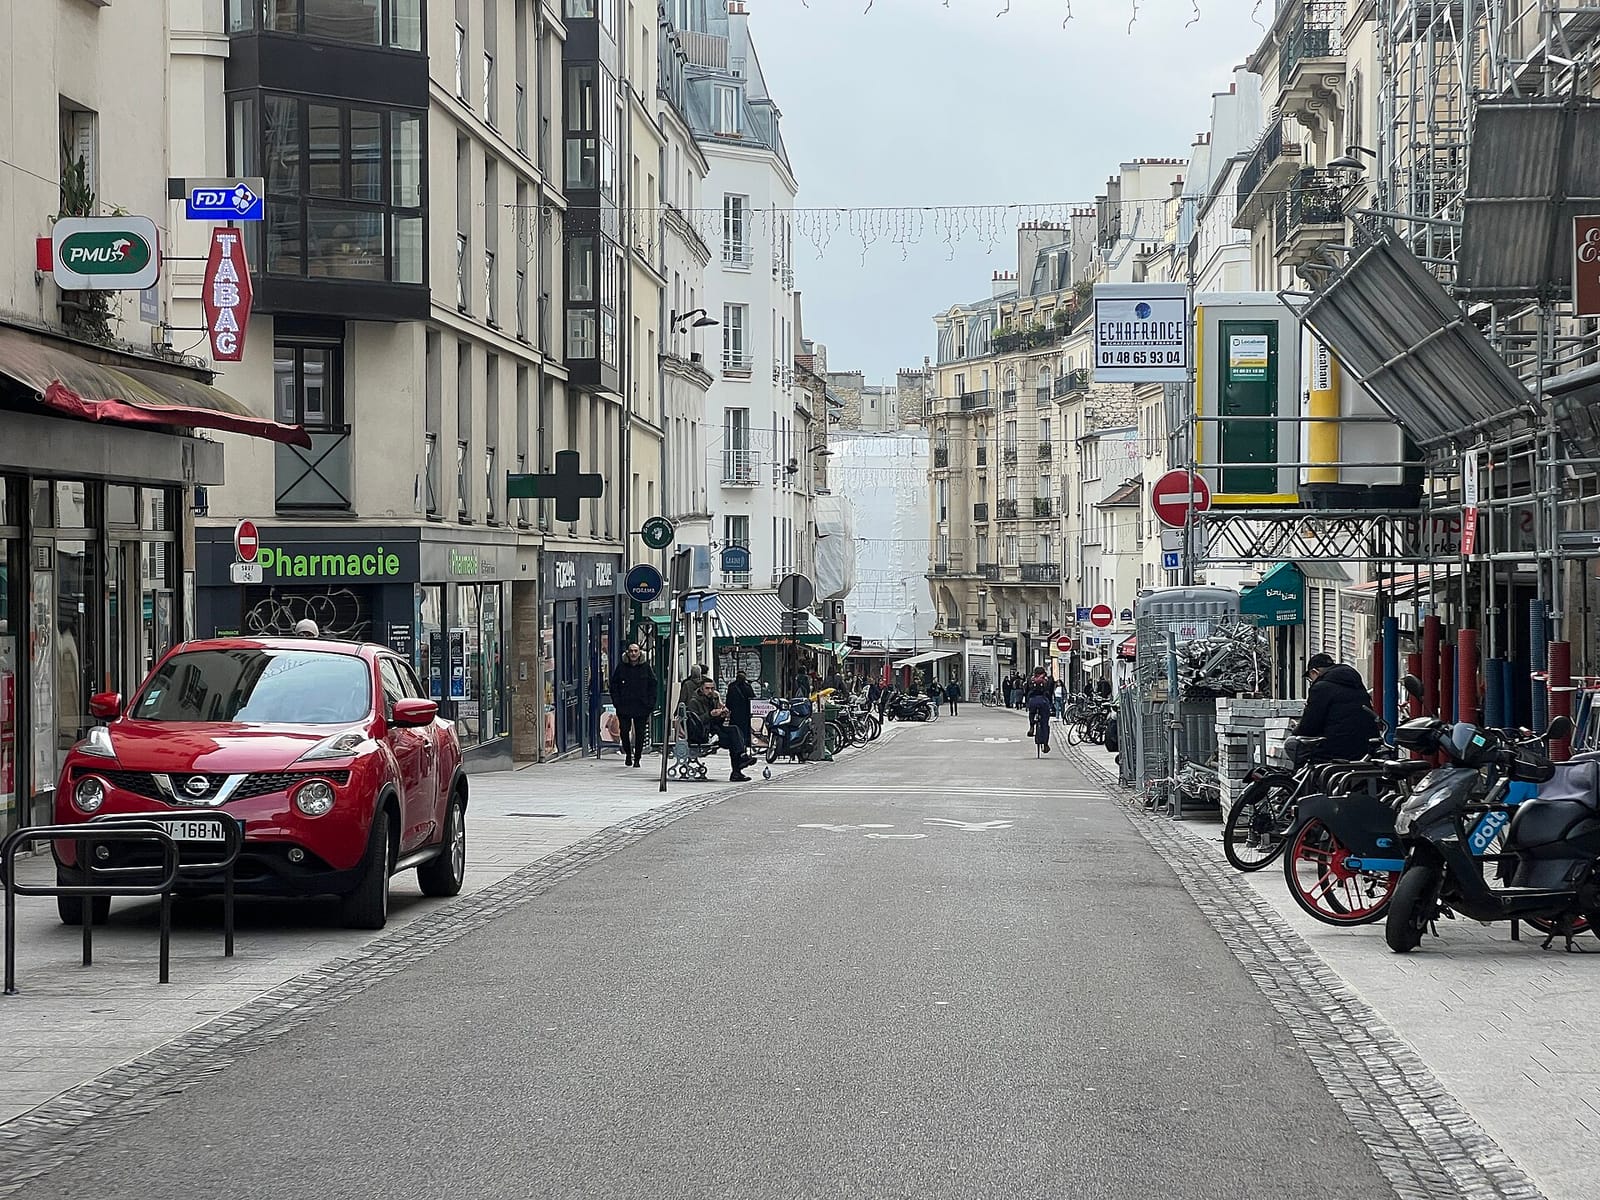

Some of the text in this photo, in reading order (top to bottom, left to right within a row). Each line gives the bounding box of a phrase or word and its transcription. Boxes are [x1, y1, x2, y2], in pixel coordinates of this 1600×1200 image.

[195, 192, 226, 206] FDJ
[70, 247, 111, 262] PMU
[213, 234, 240, 354] TABAC
[1099, 322, 1183, 341] ECHAFRANCE
[1102, 351, 1180, 364] 01 48 65 93 04
[257, 546, 400, 577] Pharmacie
[1474, 811, 1506, 848] dott
